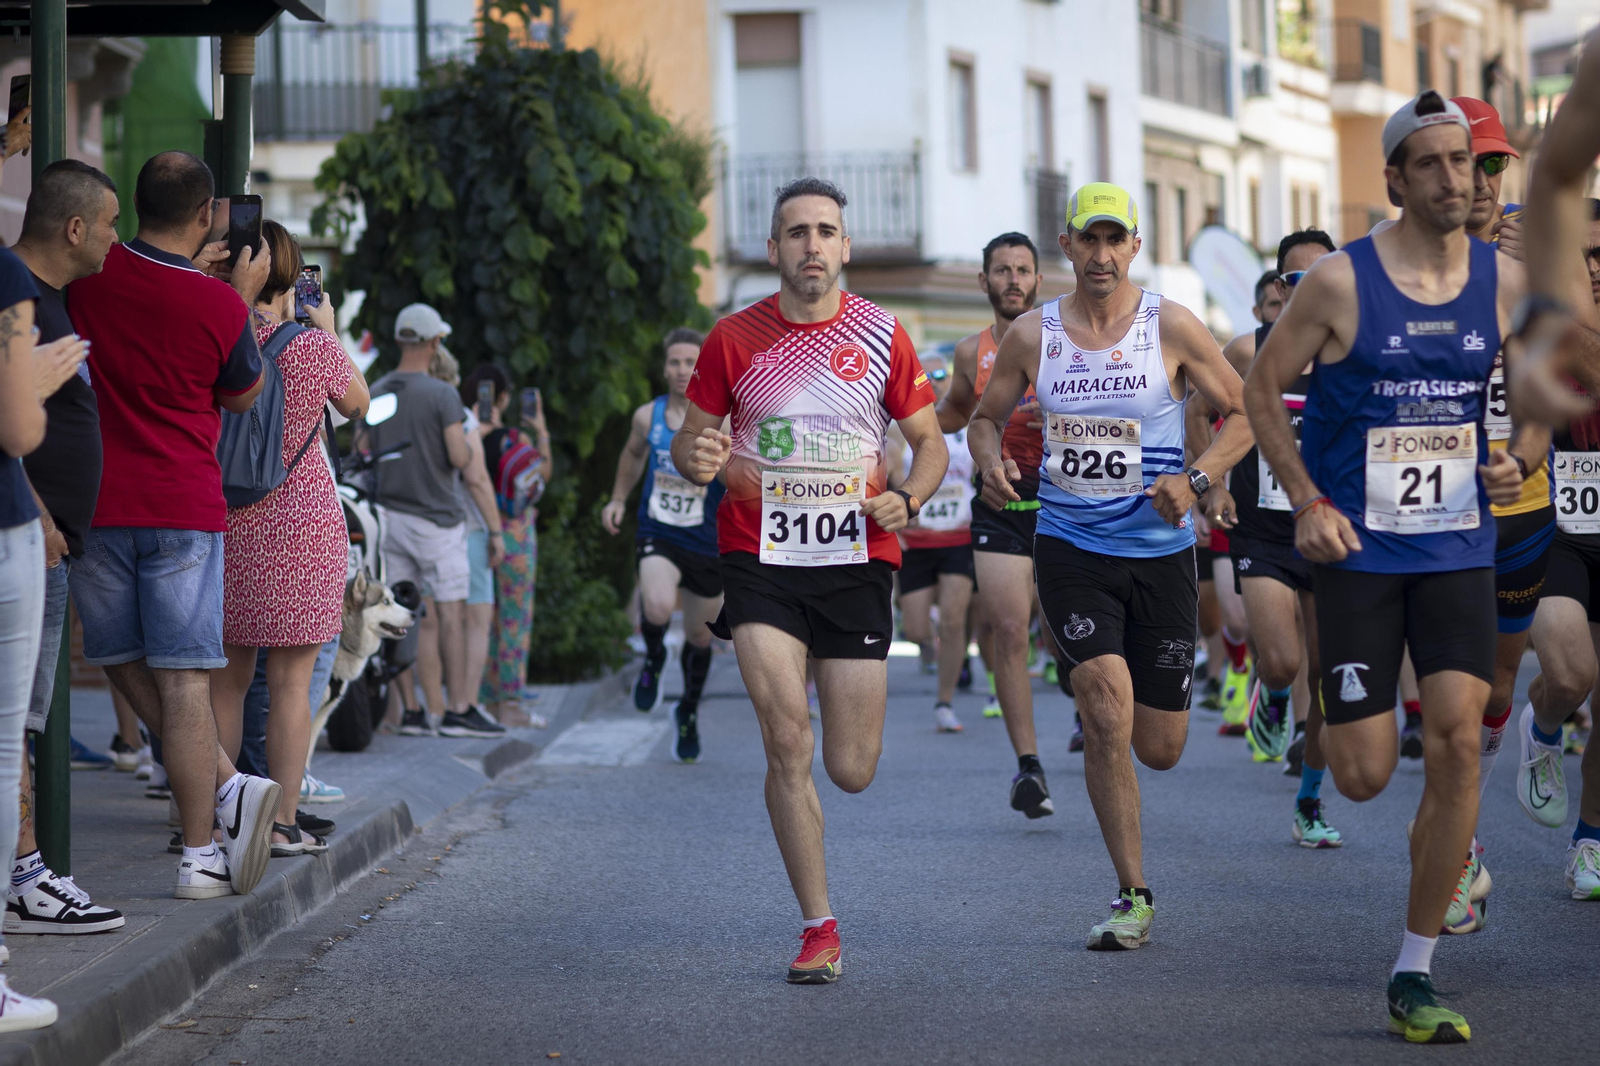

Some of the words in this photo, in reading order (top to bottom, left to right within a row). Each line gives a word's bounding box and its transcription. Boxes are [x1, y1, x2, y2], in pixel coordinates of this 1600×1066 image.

[1105, 361, 1134, 372] mayfo
[1050, 374, 1148, 396] MARACENA
[1092, 393, 1136, 401] ATLETISMO
[1064, 422, 1123, 438] FONDO
[1394, 435, 1459, 453] FONDO
[807, 477, 836, 485] PREMIO
[1399, 464, 1442, 507] 21
[784, 482, 847, 498] FONDO
[659, 492, 696, 515] 537
[924, 501, 960, 518] 447
[767, 509, 860, 545] 3104
